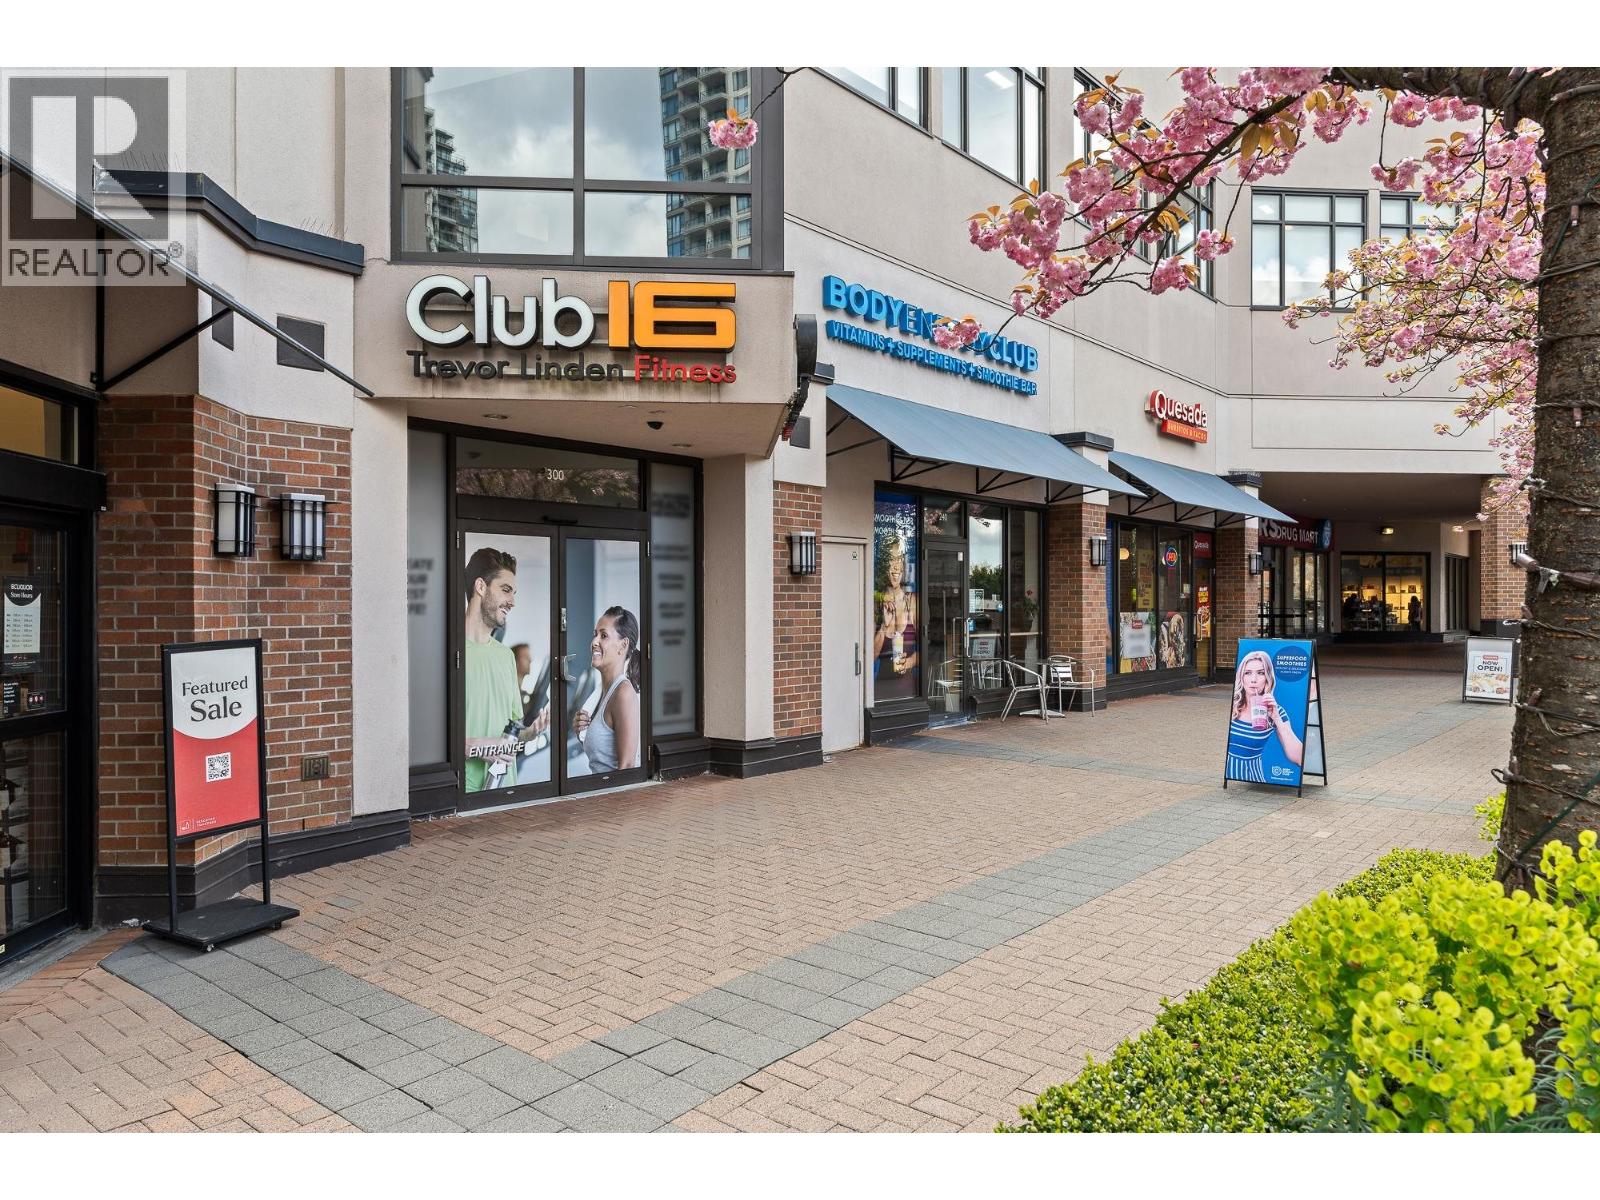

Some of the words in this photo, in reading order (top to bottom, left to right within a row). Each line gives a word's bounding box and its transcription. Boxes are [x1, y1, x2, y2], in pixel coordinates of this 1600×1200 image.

[405, 274, 596, 350] Club
[607, 279, 737, 353] 16
[822, 275, 1038, 372] BODYENYCLUB
[406, 350, 511, 379] Trevor
[520, 352, 624, 382] Linden
[634, 354, 737, 384] Fitness
[828, 320, 885, 351] VITAMINS
[897, 341, 967, 375] SUPPLEMENTS
[977, 366, 1019, 389] SMOOTHIE
[1021, 379, 1037, 395] BAR
[1154, 390, 1208, 427] Quesada
[547, 468, 564, 481] 300
[1277, 527, 1298, 542] DRUG
[1299, 529, 1319, 544] MART
[182, 675, 249, 697] Featured
[190, 697, 243, 723] Sale
[469, 741, 525, 758] ENTRANCE
